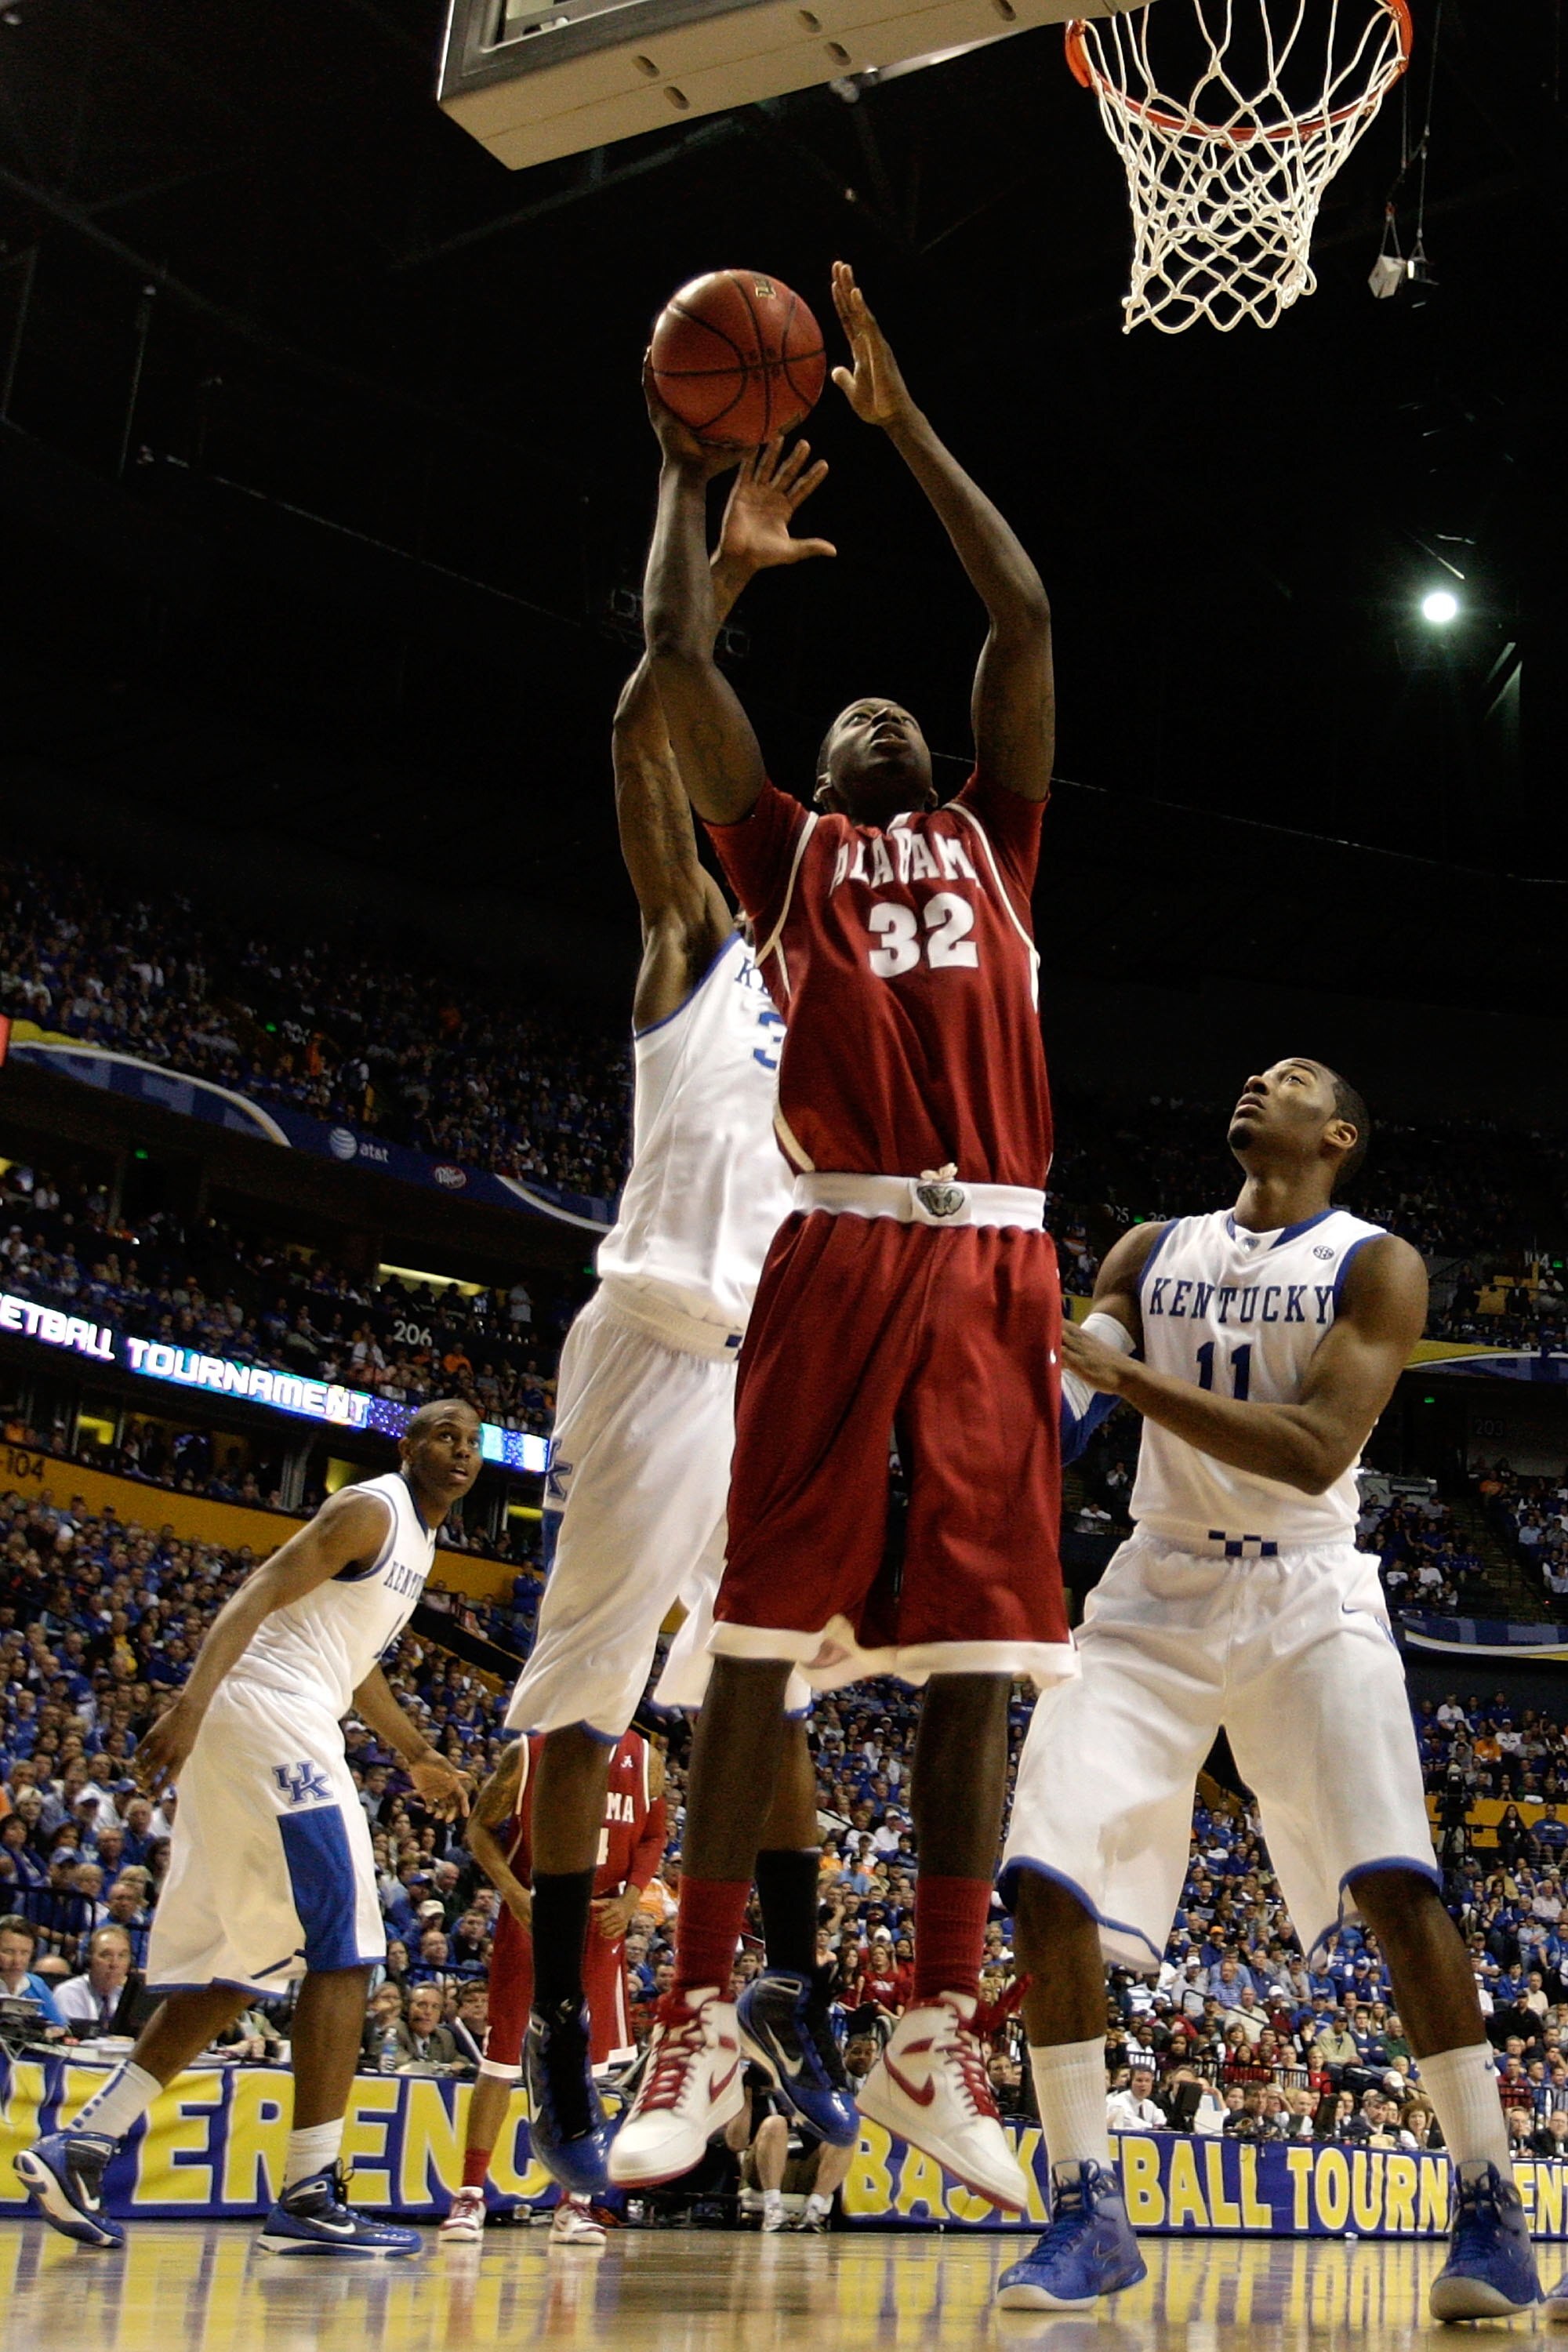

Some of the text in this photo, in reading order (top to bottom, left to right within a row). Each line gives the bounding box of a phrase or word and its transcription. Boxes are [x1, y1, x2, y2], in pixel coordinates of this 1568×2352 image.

[828, 828, 982, 898] ALABAM
[869, 892, 978, 978] 32
[1149, 1278, 1334, 1324] KENTUCKY
[0, 1292, 372, 1424] ETBALL TOURNAMENT
[393, 1319, 433, 1347] 206
[1196, 1341, 1252, 1401] 11
[274, 1761, 333, 1804] UK
